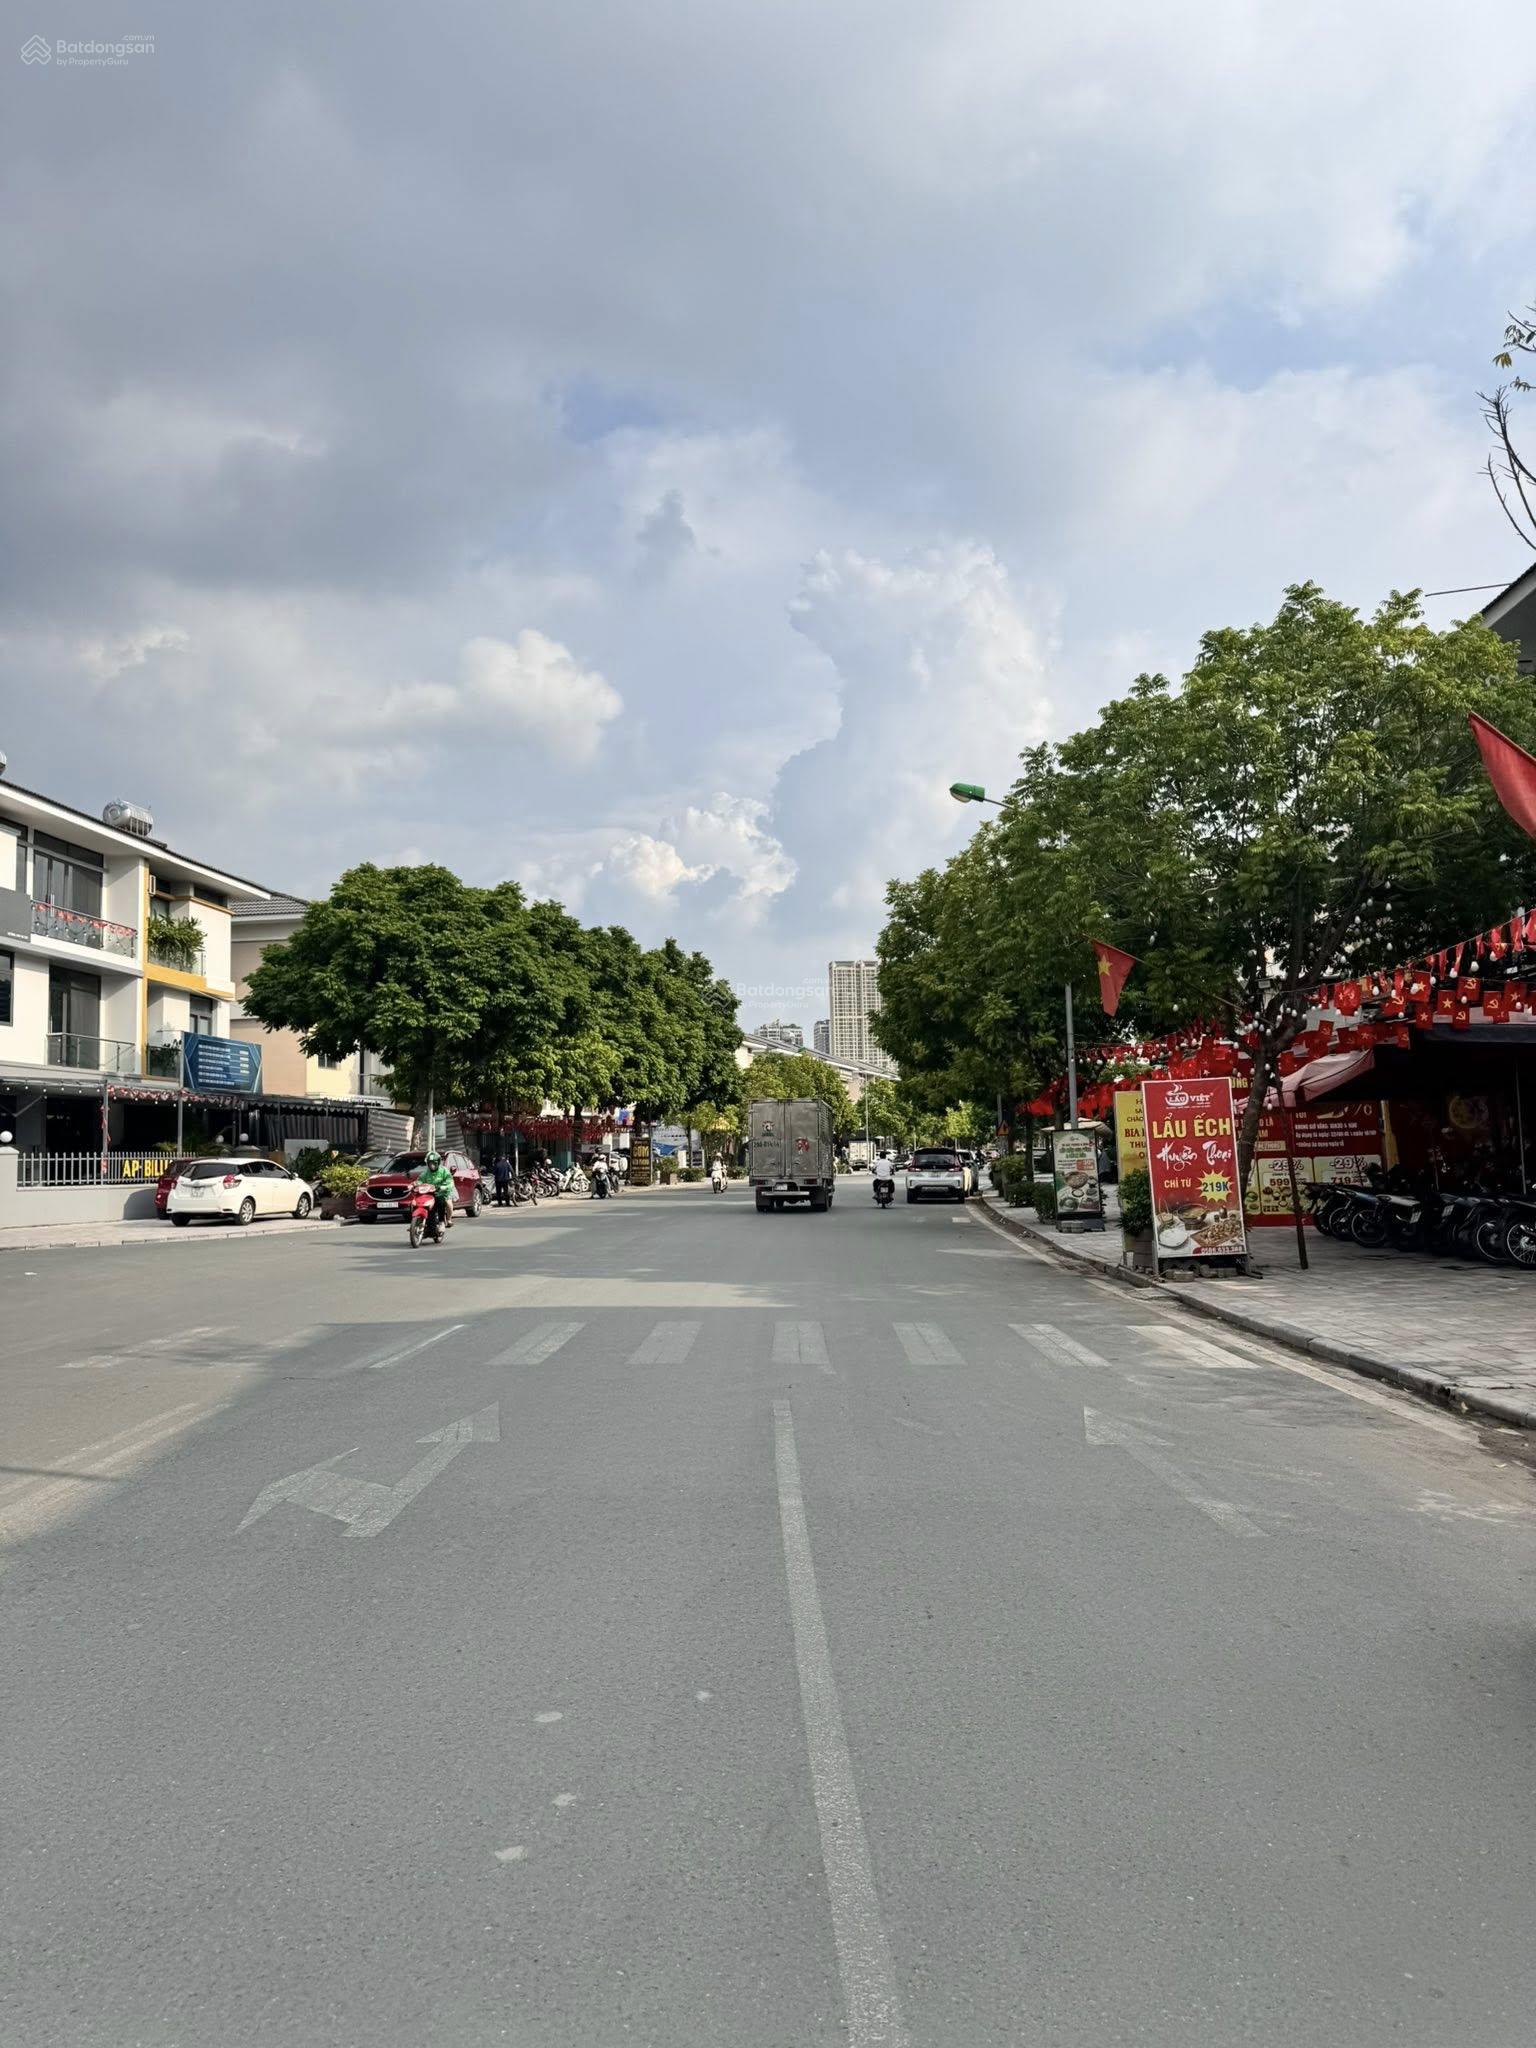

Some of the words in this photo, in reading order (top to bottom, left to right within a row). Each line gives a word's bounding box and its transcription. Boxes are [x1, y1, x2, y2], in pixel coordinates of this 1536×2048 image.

[1152, 1112, 1187, 1139] LẨU
[1193, 1112, 1232, 1137] ẾCH
[1156, 1141, 1198, 1171] Huyền
[1202, 1140, 1232, 1165] Thoại
[122, 1159, 139, 1177] AP
[1164, 1177, 1179, 1189] CHỈ
[1180, 1176, 1192, 1188] TỪ
[1202, 1181, 1229, 1192] 219K
